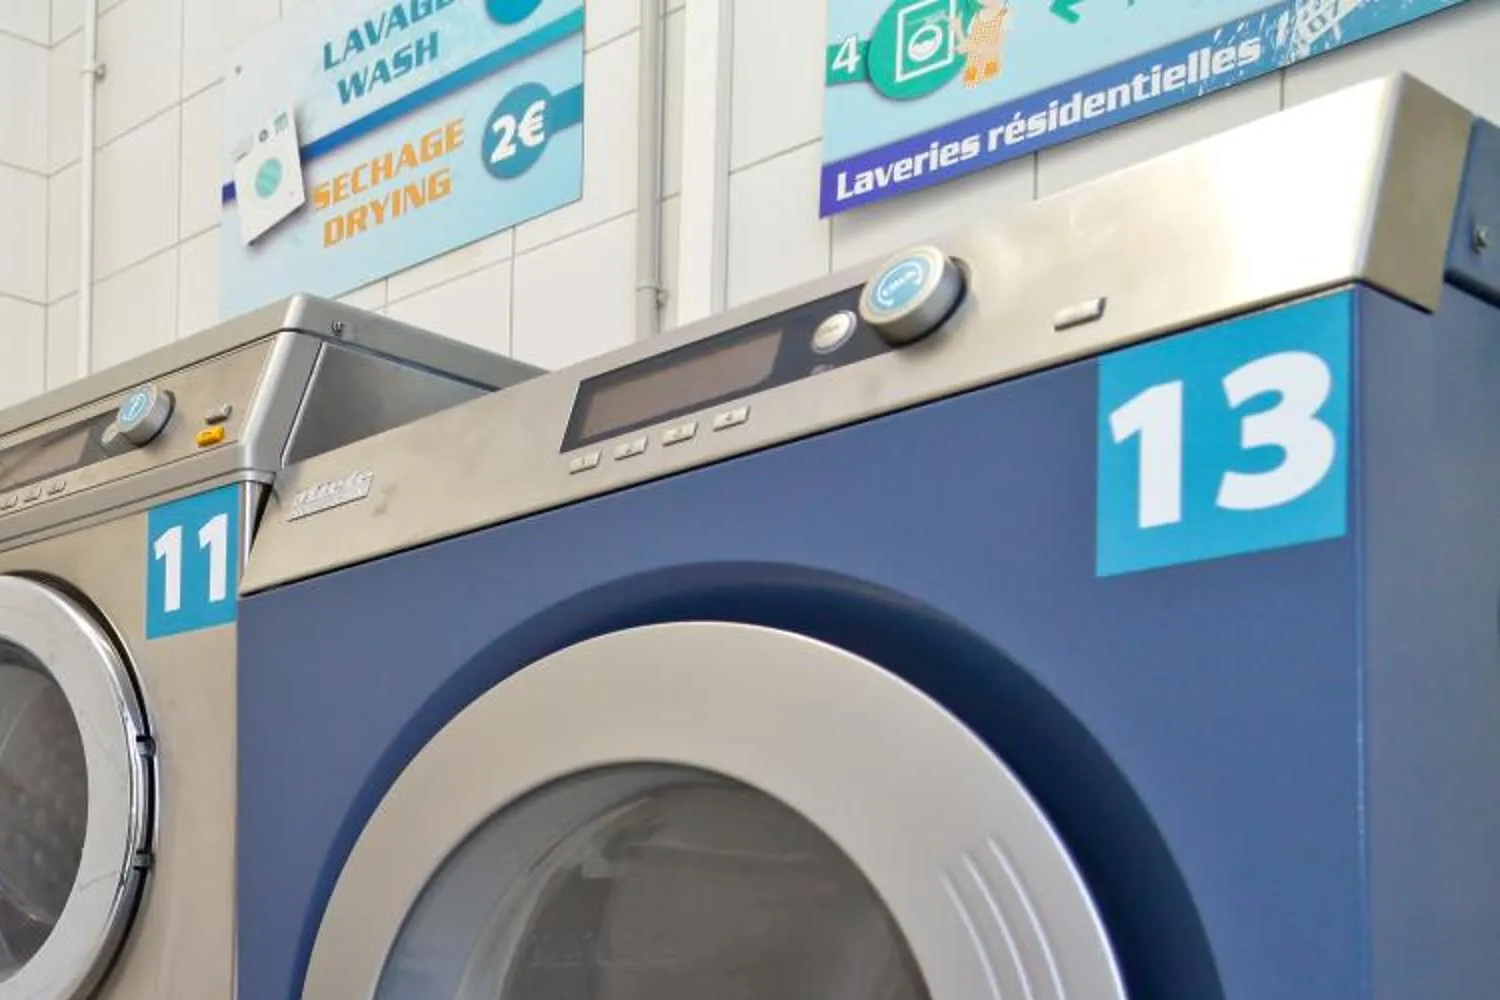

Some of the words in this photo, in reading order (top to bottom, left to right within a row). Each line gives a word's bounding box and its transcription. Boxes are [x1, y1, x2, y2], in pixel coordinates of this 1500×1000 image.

[337, 31, 439, 105] WASH
[831, 35, 862, 73] 4
[490, 99, 547, 165] 2€
[836, 132, 981, 201] Laveries
[986, 37, 1261, 147] résidentielles
[311, 117, 465, 211] SECHAGE
[323, 167, 452, 249] DRYING
[1108, 350, 1337, 529] 13
[153, 512, 229, 613] 11
